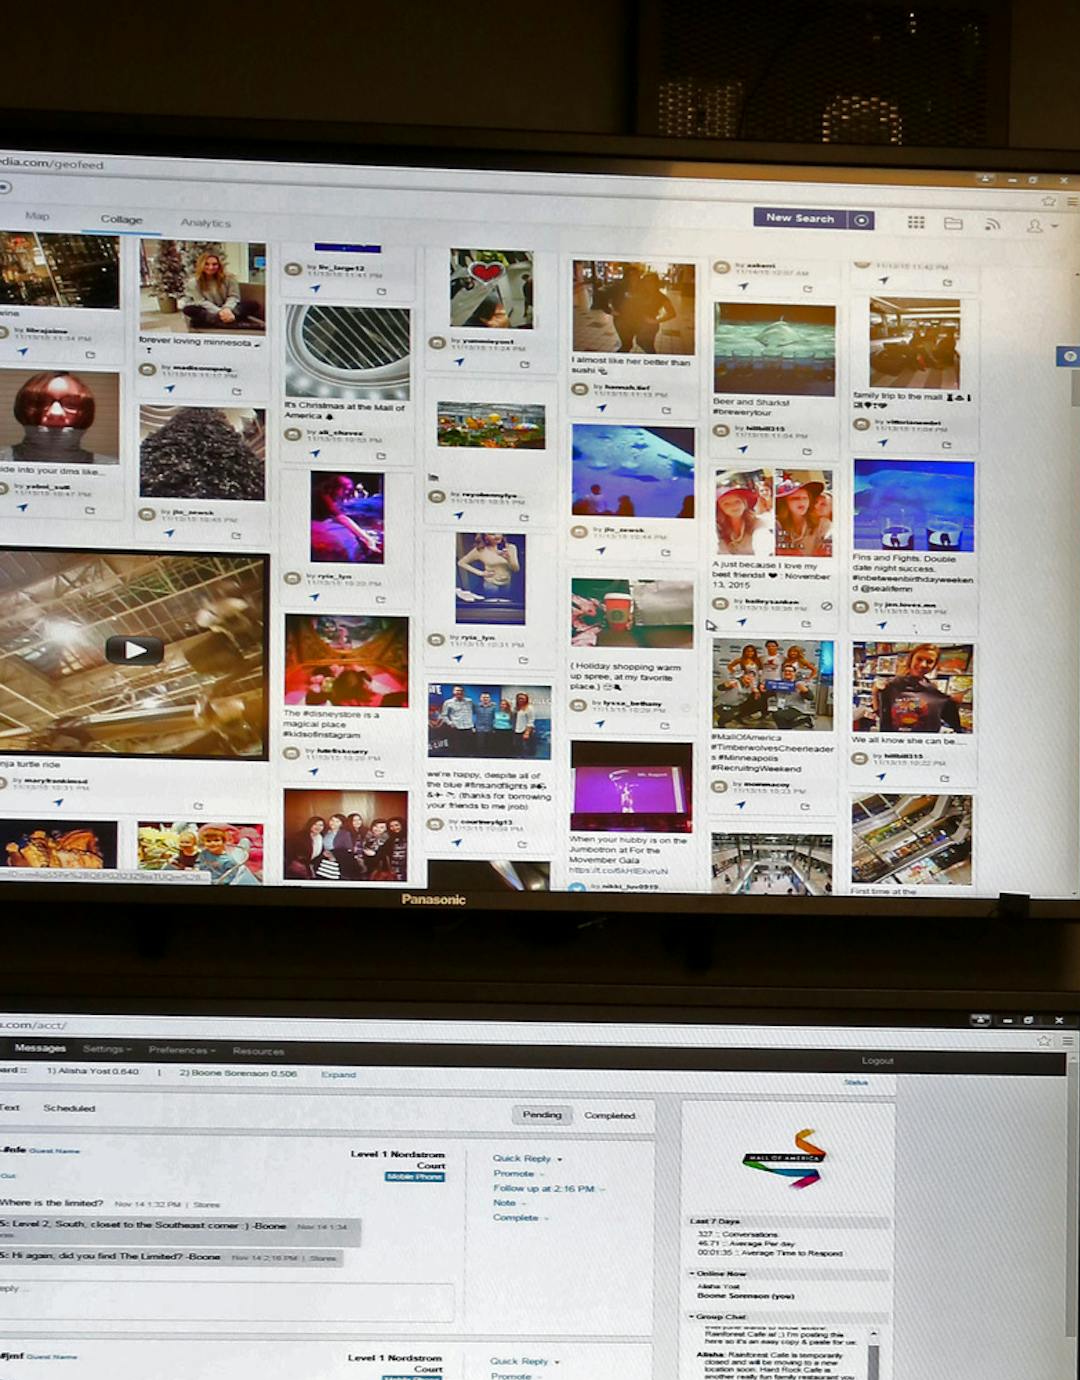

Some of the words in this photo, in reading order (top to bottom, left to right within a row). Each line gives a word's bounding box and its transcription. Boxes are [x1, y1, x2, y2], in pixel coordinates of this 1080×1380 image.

[25, 211, 50, 222] Map
[101, 215, 143, 226] Collage
[796, 214, 834, 223] Search
[181, 219, 231, 228] Analytics
[173, 338, 201, 346] loving
[713, 397, 734, 405] Beer
[713, 408, 771, 416] #brewerytour
[283, 730, 360, 739] #kidsofinstagram
[402, 893, 466, 905] Panasonic
[15, 1044, 66, 1053] Messages
[83, 1045, 124, 1054] Settings
[149, 1046, 207, 1054] Preferences
[233, 1047, 285, 1055] Resources
[862, 1057, 894, 1066] Logout
[321, 1071, 356, 1079] Expand
[44, 1104, 95, 1112] Scheduled
[523, 1111, 562, 1120] Pending
[585, 1112, 636, 1120] Completed
[524, 1154, 551, 1163] Reply
[417, 1162, 445, 1170] Court
[494, 1170, 534, 1178] Promote
[493, 1214, 539, 1222] Complete
